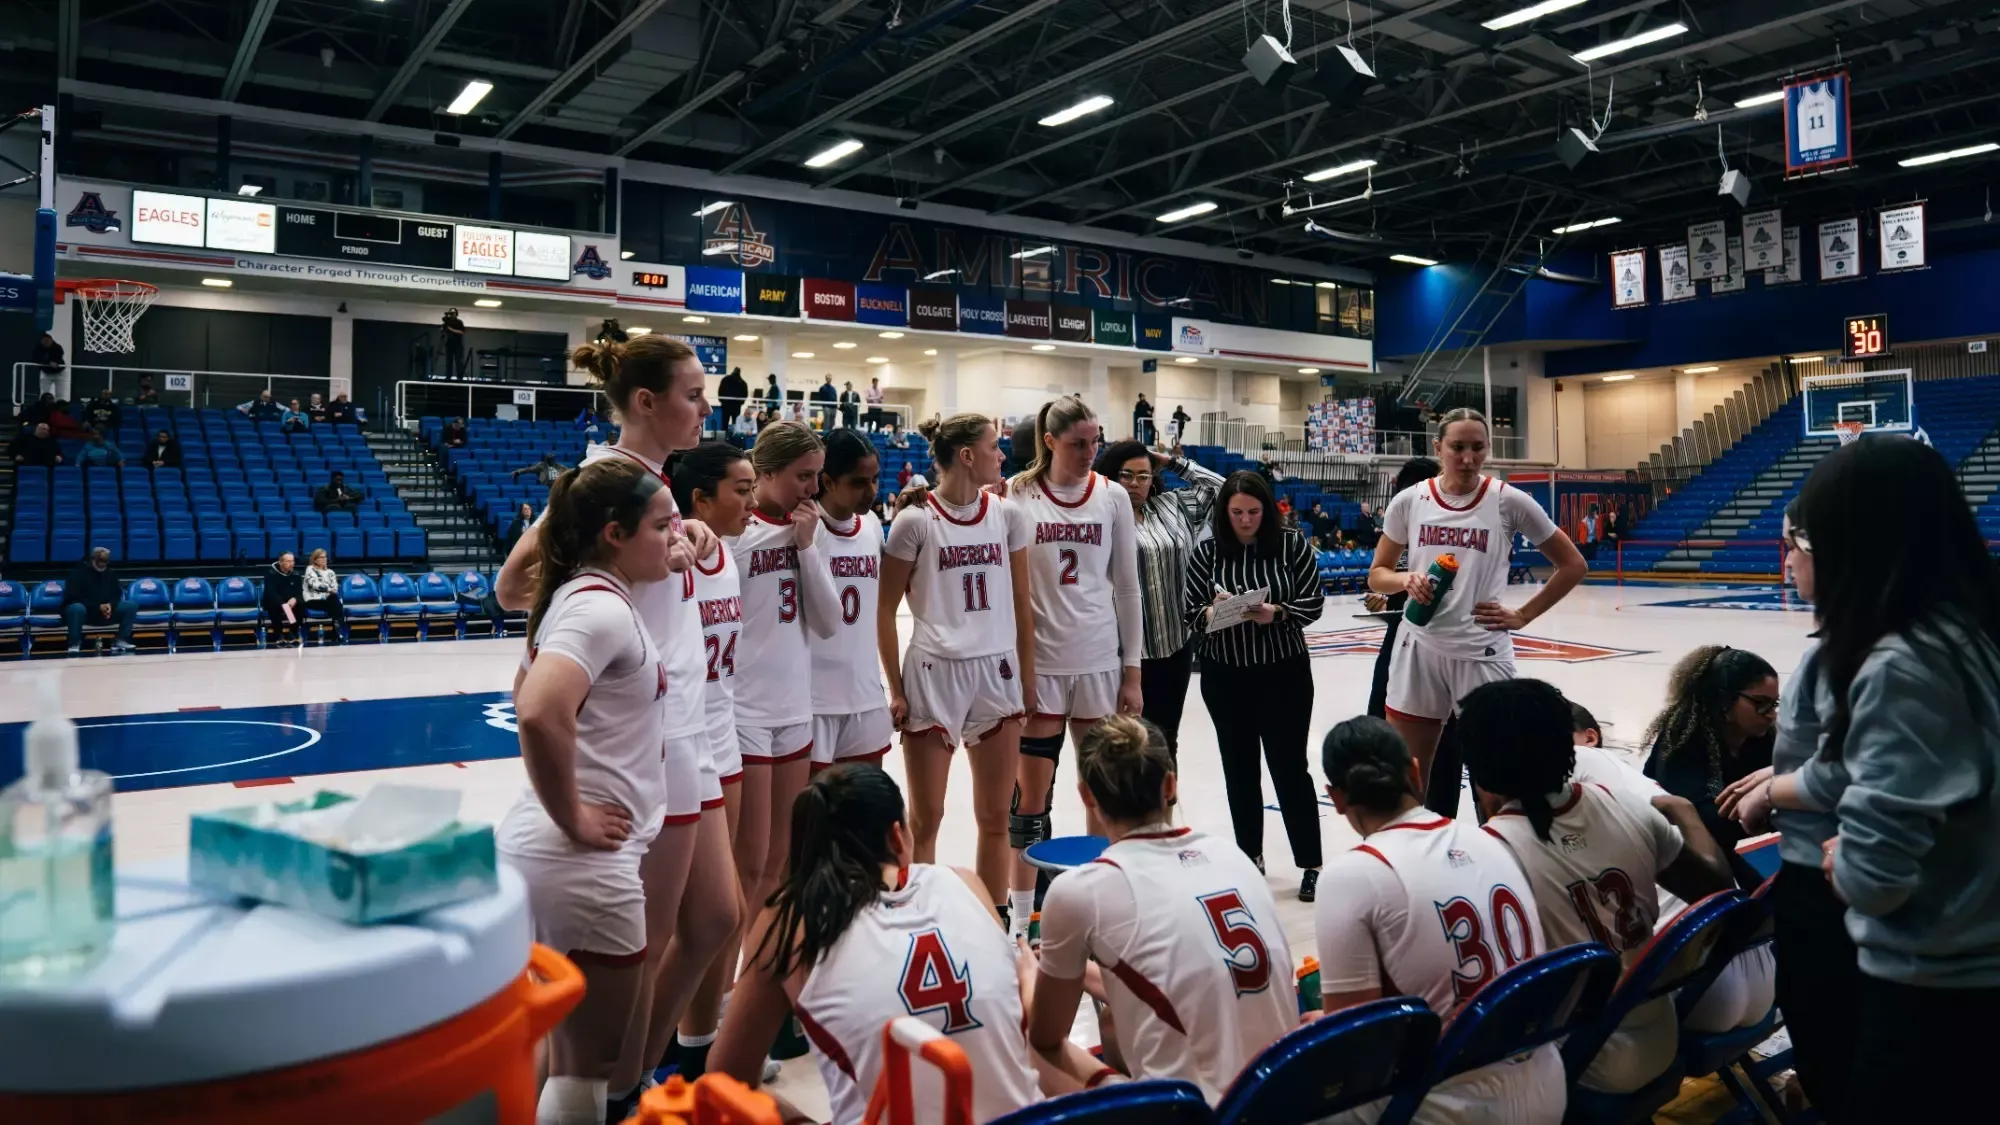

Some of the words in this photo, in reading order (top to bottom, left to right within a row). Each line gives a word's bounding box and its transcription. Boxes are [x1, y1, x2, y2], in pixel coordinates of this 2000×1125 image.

[1808, 114, 1825, 130] 11
[138, 207, 200, 227] EAGLES
[286, 212, 316, 225] HOME
[417, 226, 449, 239] GUEST
[462, 231, 494, 242] FOLLOW
[495, 234, 508, 244] THE
[341, 245, 369, 256] PERIOD
[462, 240, 508, 259] EAGLES
[237, 259, 305, 274] Character
[307, 265, 352, 279] Forged
[355, 269, 408, 283] Through
[410, 274, 484, 289] Competition
[863, 221, 1273, 327] AMERICAN
[689, 283, 741, 298] AMERICAN
[759, 288, 786, 303] ARMY
[814, 292, 846, 306] BOSTON
[859, 297, 904, 312] BUCKNELL
[916, 304, 953, 318] COLGATE
[960, 308, 979, 321] HOLY
[980, 309, 1004, 322] CROSS
[1008, 313, 1049, 328] LAFAYETTE
[1059, 317, 1086, 330] LEHIGH
[1100, 321, 1127, 334] LOYOLA
[1850, 319, 1877, 334] 37.1
[1144, 327, 1162, 338] NAVY
[692, 336, 716, 346] ARENA
[1854, 330, 1881, 354] 30
[170, 377, 186, 387] 102
[518, 392, 531, 401] 103
[1034, 521, 1103, 547] AMERICAN
[1417, 524, 1490, 553] AMERICAN
[748, 545, 801, 578] AMER
[937, 543, 1004, 572] AMERICAN
[829, 554, 879, 580] MERICAN
[1059, 548, 1080, 586] 2
[962, 571, 992, 613] 11
[778, 577, 799, 624] 3
[840, 584, 861, 626] 0
[703, 630, 739, 683] 24
[1195, 888, 1272, 999] 5
[1433, 883, 1536, 1007] 30
[897, 927, 984, 1036] 4
